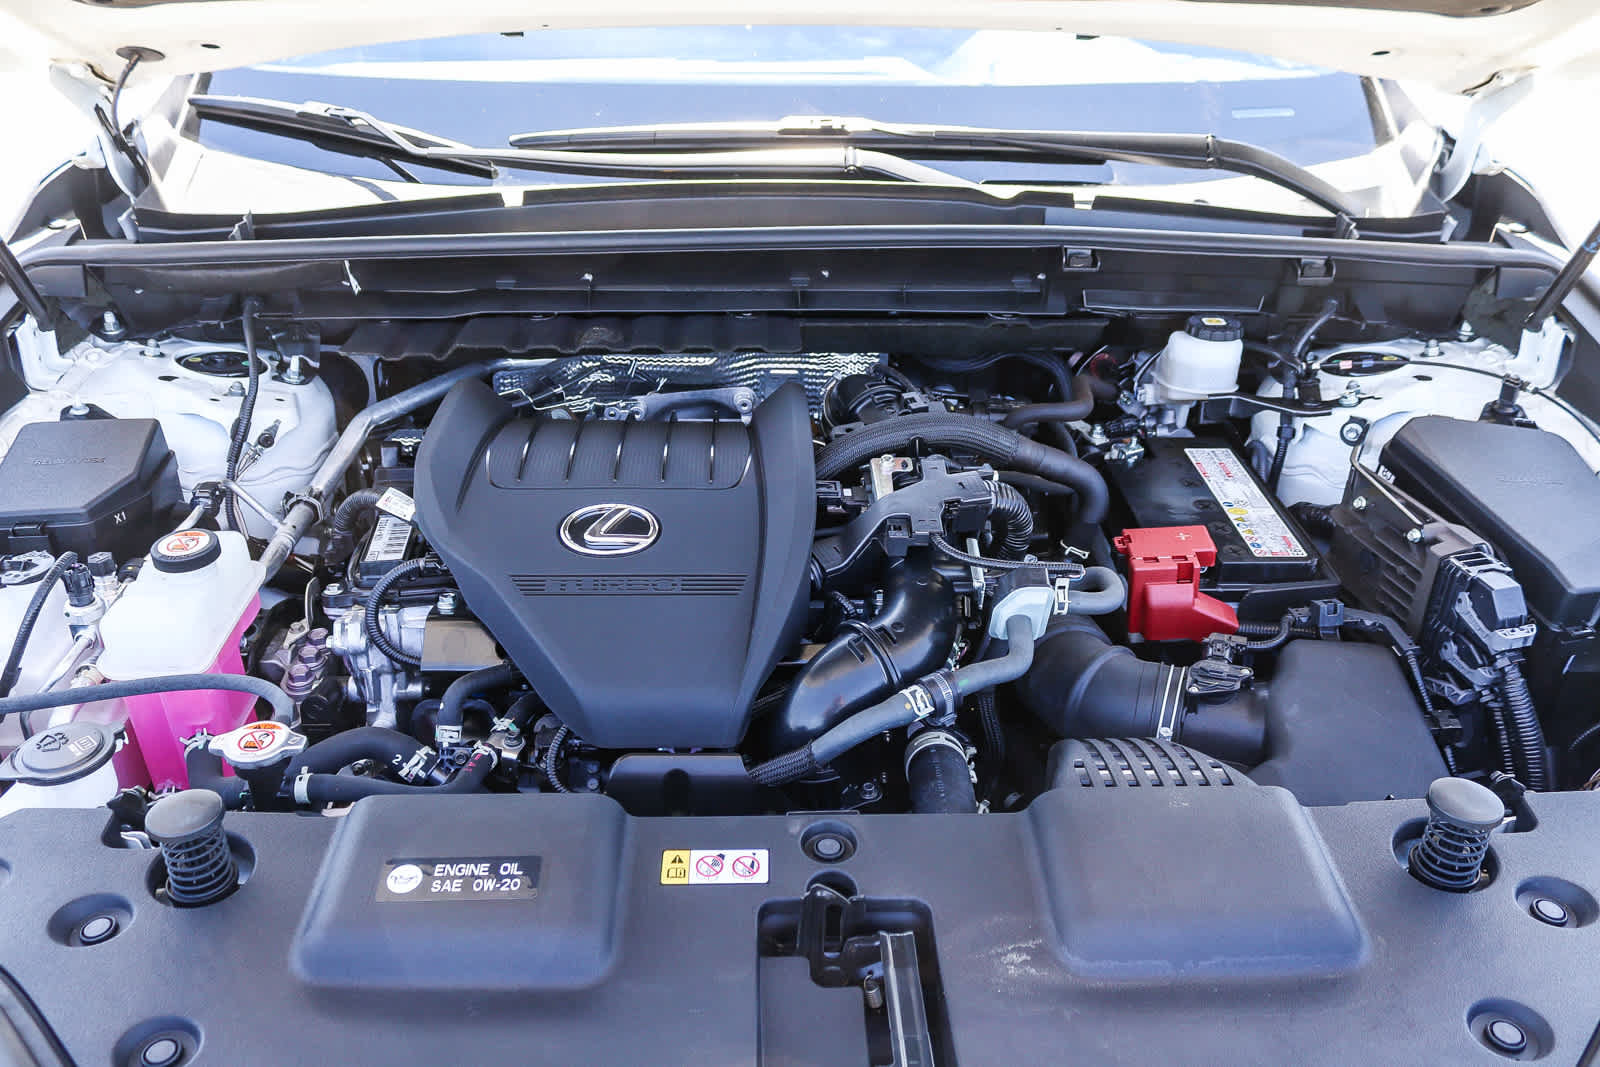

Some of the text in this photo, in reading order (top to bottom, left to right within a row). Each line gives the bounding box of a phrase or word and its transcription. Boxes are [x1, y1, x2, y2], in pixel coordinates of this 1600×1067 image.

[114, 511, 127, 524] X1
[392, 754, 402, 765] 2
[433, 863, 523, 877] ENGINE OIL
[431, 878, 521, 892] SAE 0W-20
